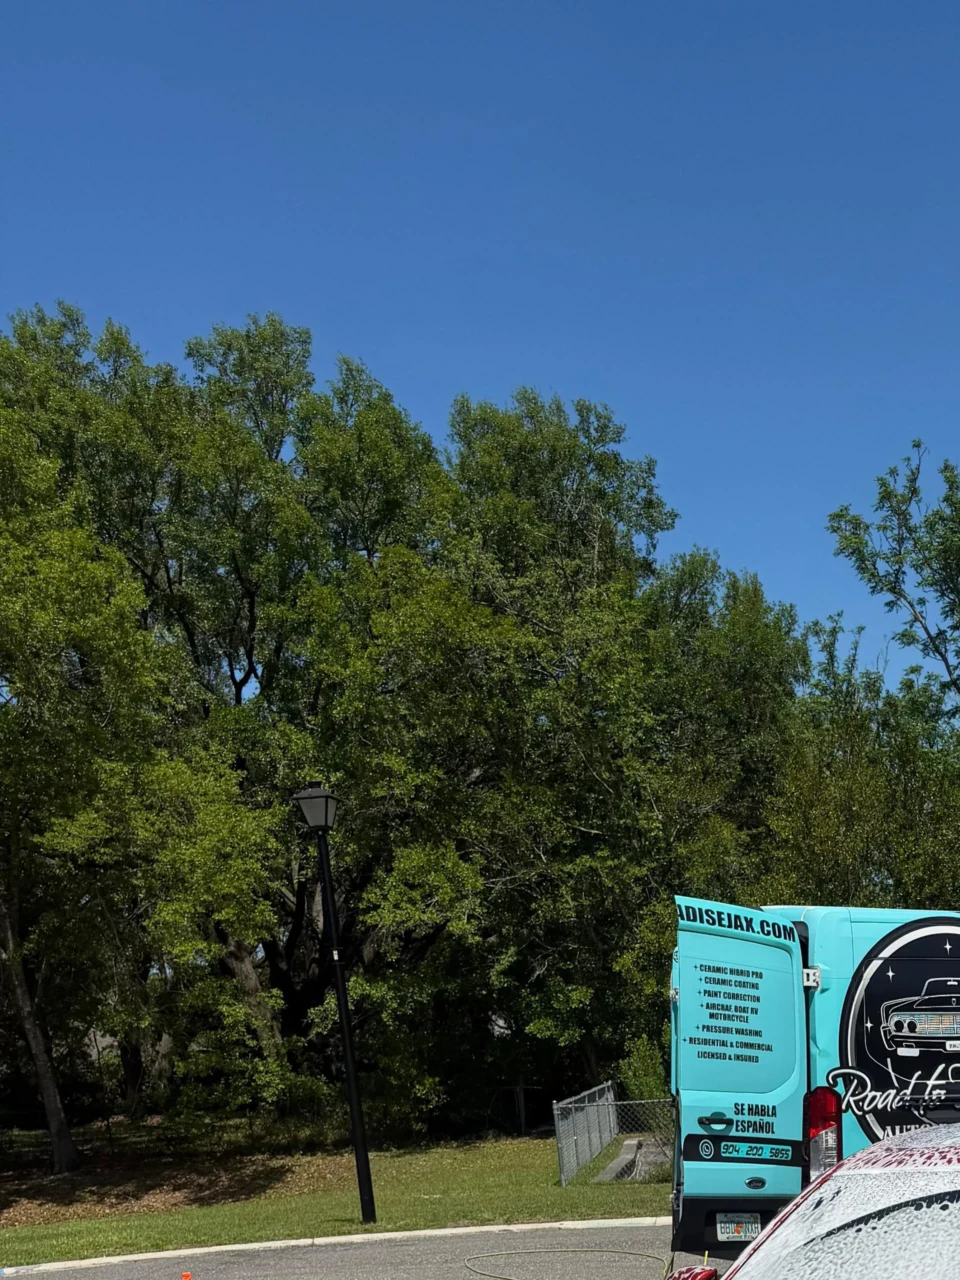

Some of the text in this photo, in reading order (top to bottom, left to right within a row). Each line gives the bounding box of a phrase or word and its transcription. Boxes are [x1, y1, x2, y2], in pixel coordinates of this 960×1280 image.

[699, 964, 763, 980] CERAMIC HIBRID PRO
[704, 976, 759, 990] CERAMIC COATING
[703, 989, 760, 1003] PAINT CORRECTION
[734, 1005, 749, 1014] BOAT
[750, 1007, 759, 1015] RV
[709, 1013, 749, 1023] MOTORCYCLE
[702, 1024, 763, 1038] PRESSURE WASHING
[688, 1036, 729, 1048] RESIDENTIAL
[735, 1041, 773, 1052] COMMERCIAL
[697, 1051, 727, 1061] LICENSED
[733, 1054, 759, 1064] INSURED
[829, 1070, 922, 1115] Road
[734, 1102, 777, 1118] SE HABLA
[735, 1118, 775, 1134] ESPAÑOL
